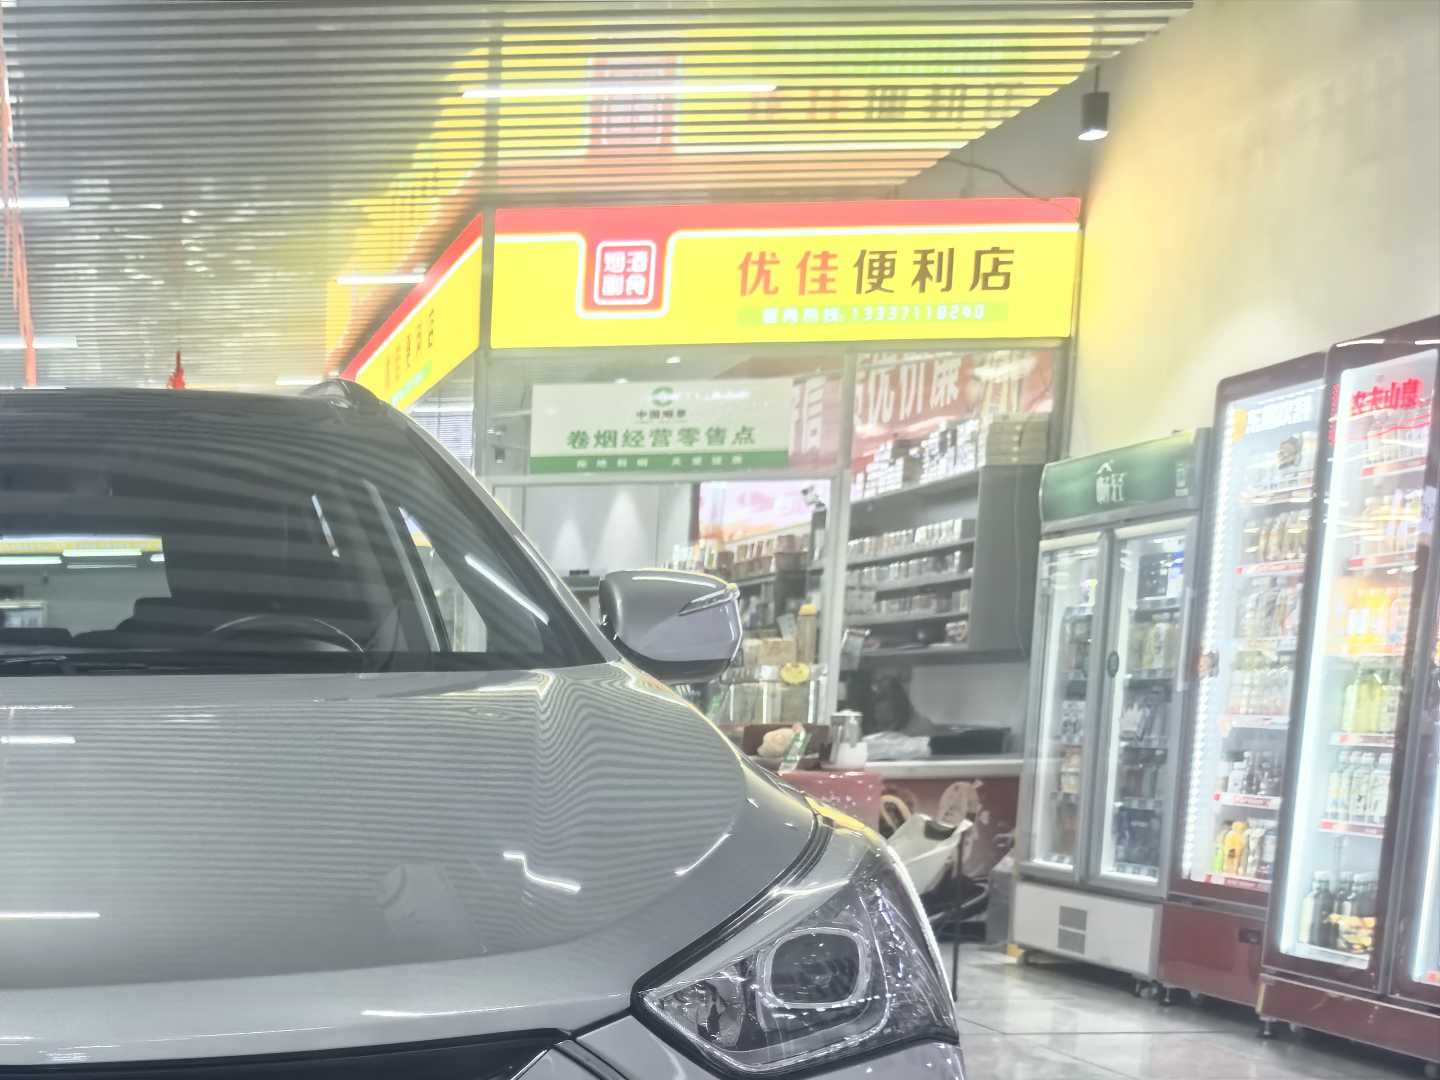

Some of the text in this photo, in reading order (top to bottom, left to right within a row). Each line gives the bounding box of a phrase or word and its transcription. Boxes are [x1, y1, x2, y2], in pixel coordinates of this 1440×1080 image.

[738, 246, 1015, 297] 优佳便利店
[567, 425, 756, 450] 卷烟经营零售点
